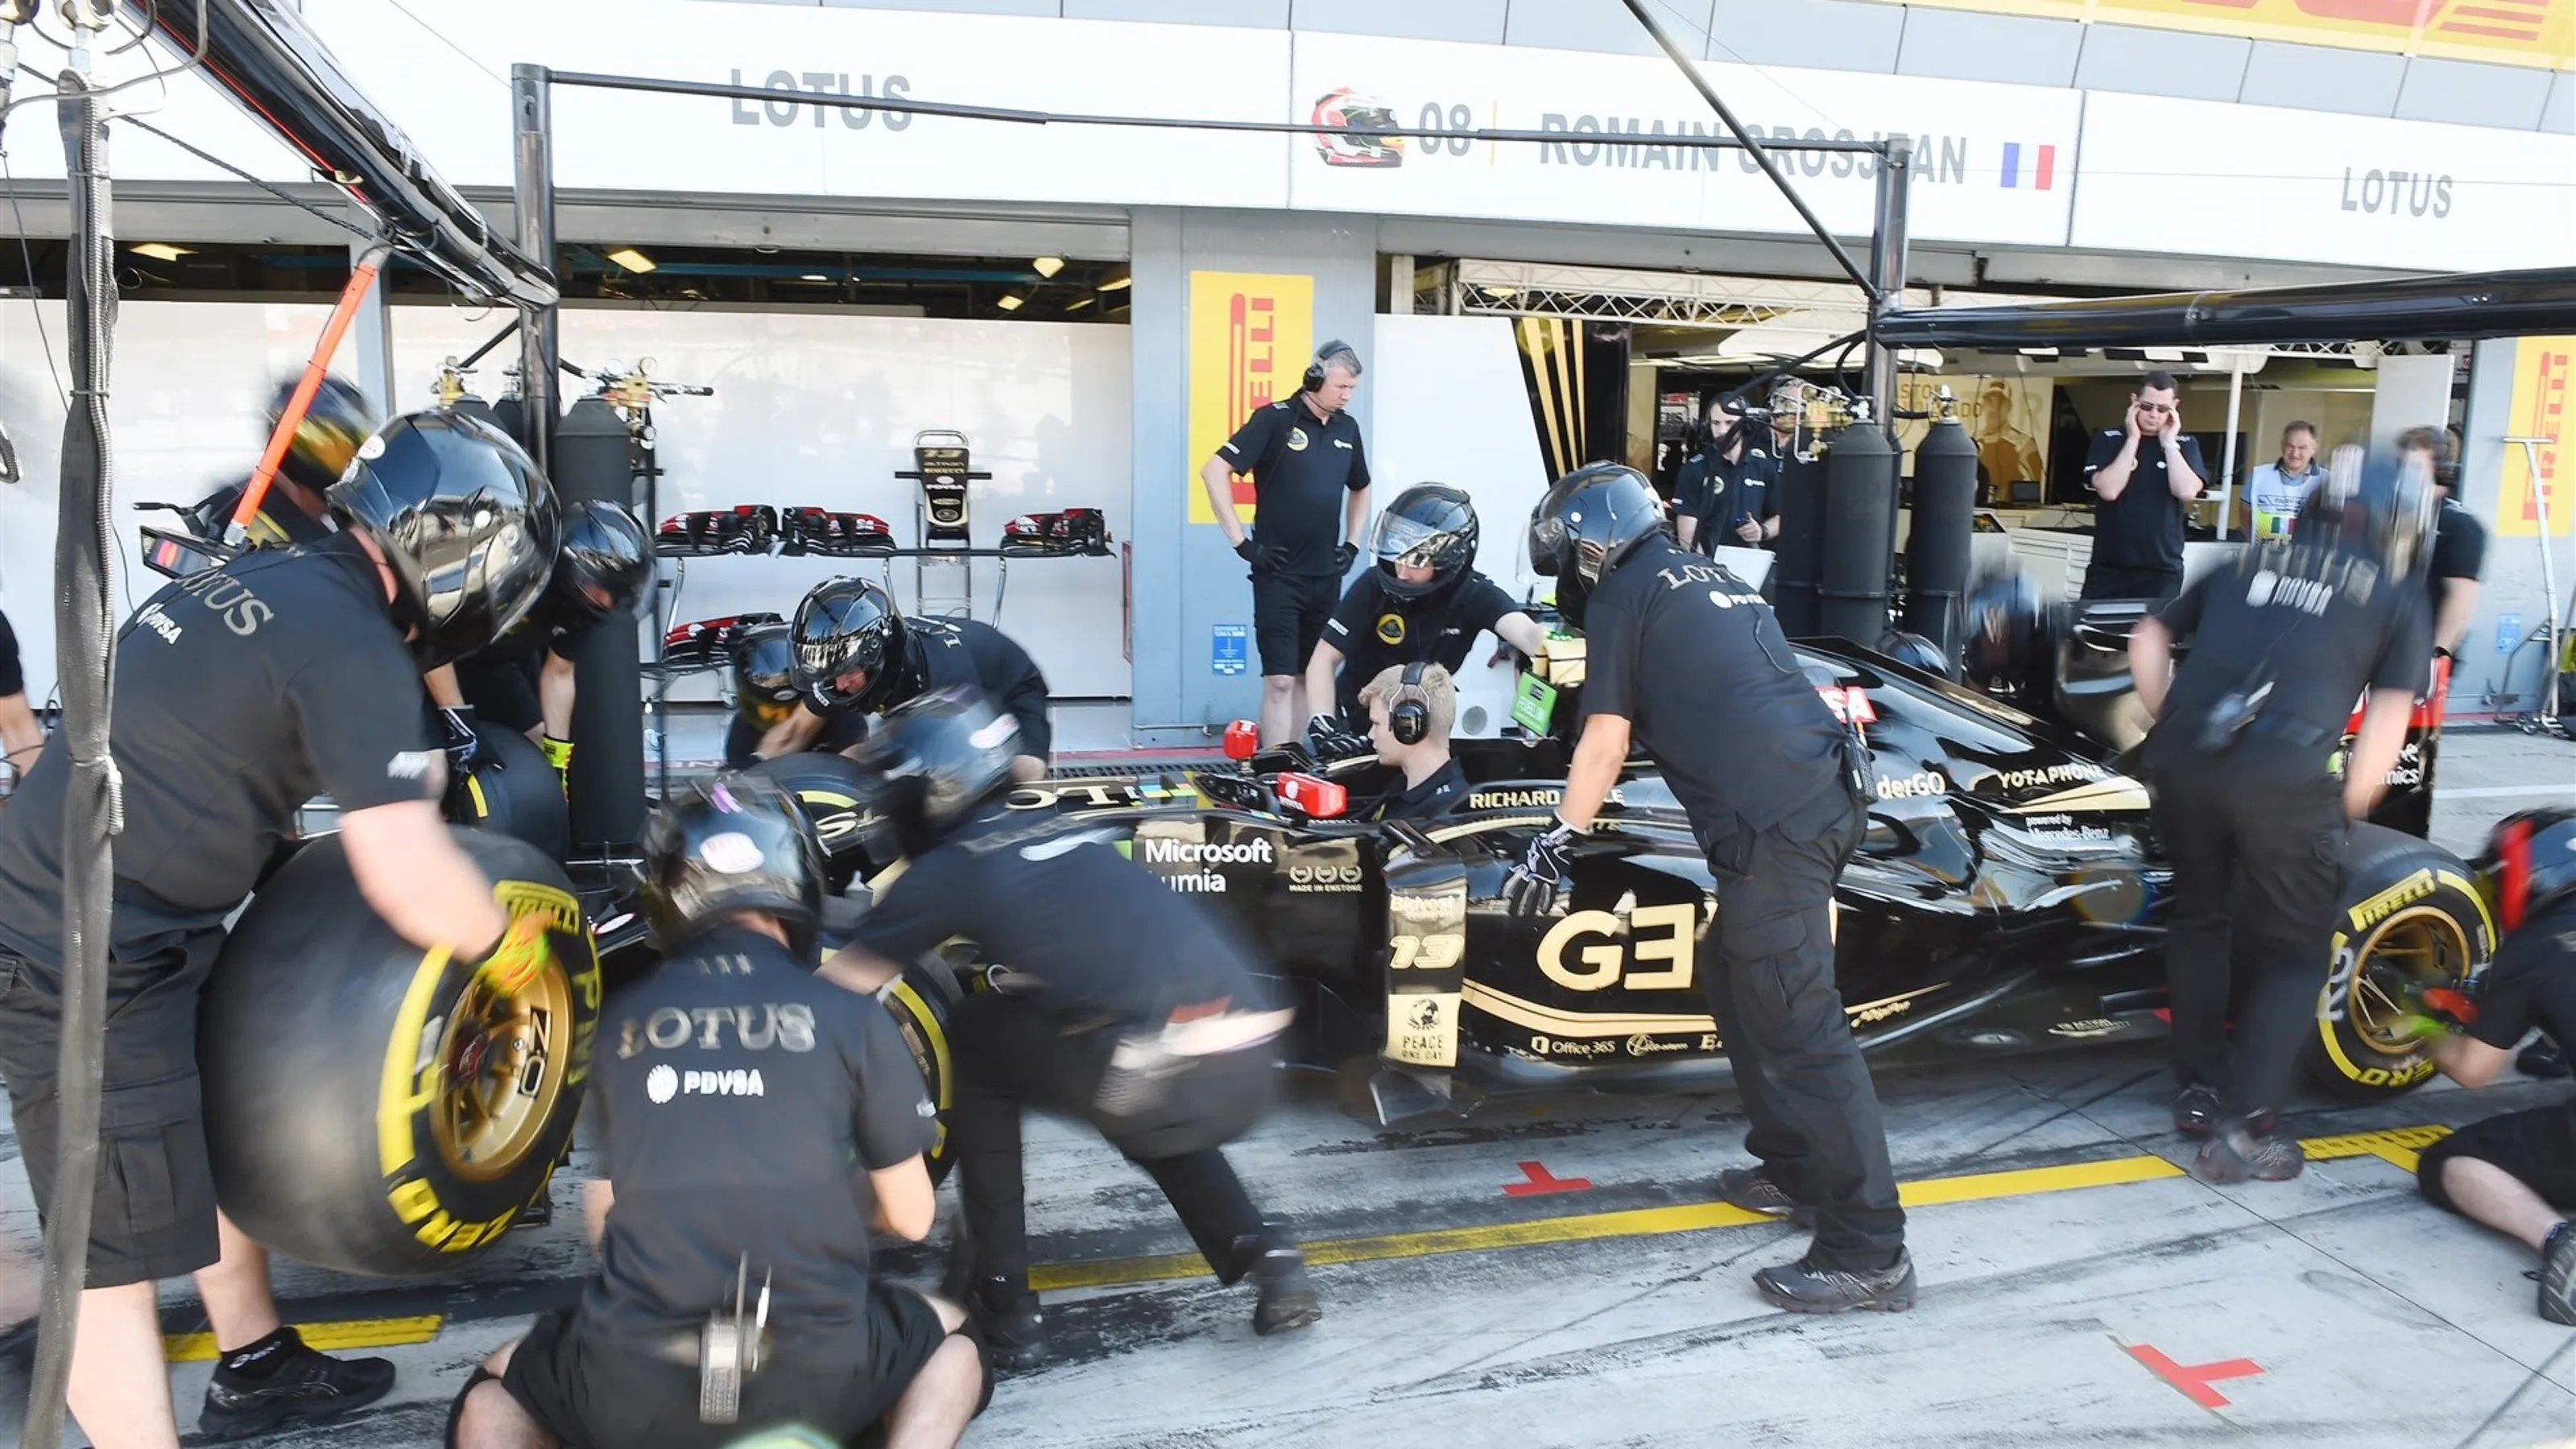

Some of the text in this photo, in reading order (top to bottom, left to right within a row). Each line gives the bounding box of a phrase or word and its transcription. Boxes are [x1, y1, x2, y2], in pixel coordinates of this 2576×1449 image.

[730, 68, 912, 131] LOTUS
[1419, 102, 1966, 184] 08 ROMAIN GROSJAN
[2341, 166, 2453, 219] LOTUS
[1229, 293, 1274, 505] PELLI
[1657, 564, 1746, 590] LOTU
[1876, 771, 1945, 799] derGO
[1998, 765, 2104, 790] YOTAPHONE
[1470, 790, 1561, 809] RICHARD
[1145, 837, 1272, 864] Microsoft
[1149, 869, 1226, 893] umia
[1325, 884, 1362, 892] ENSTONE
[493, 880, 579, 935] PIRLLI
[2347, 868, 2435, 932] PIRELLI
[1390, 935, 1465, 969] 13
[616, 1003, 816, 1059] LOTUS
[1402, 1035, 1443, 1050] PEACE
[1402, 1050, 1420, 1059] ONE
[1552, 1041, 1590, 1055] Office
[1592, 1040, 1616, 1054] 365
[684, 1069, 764, 1097] PDVSA
[2356, 1057, 2434, 1088] ERO
